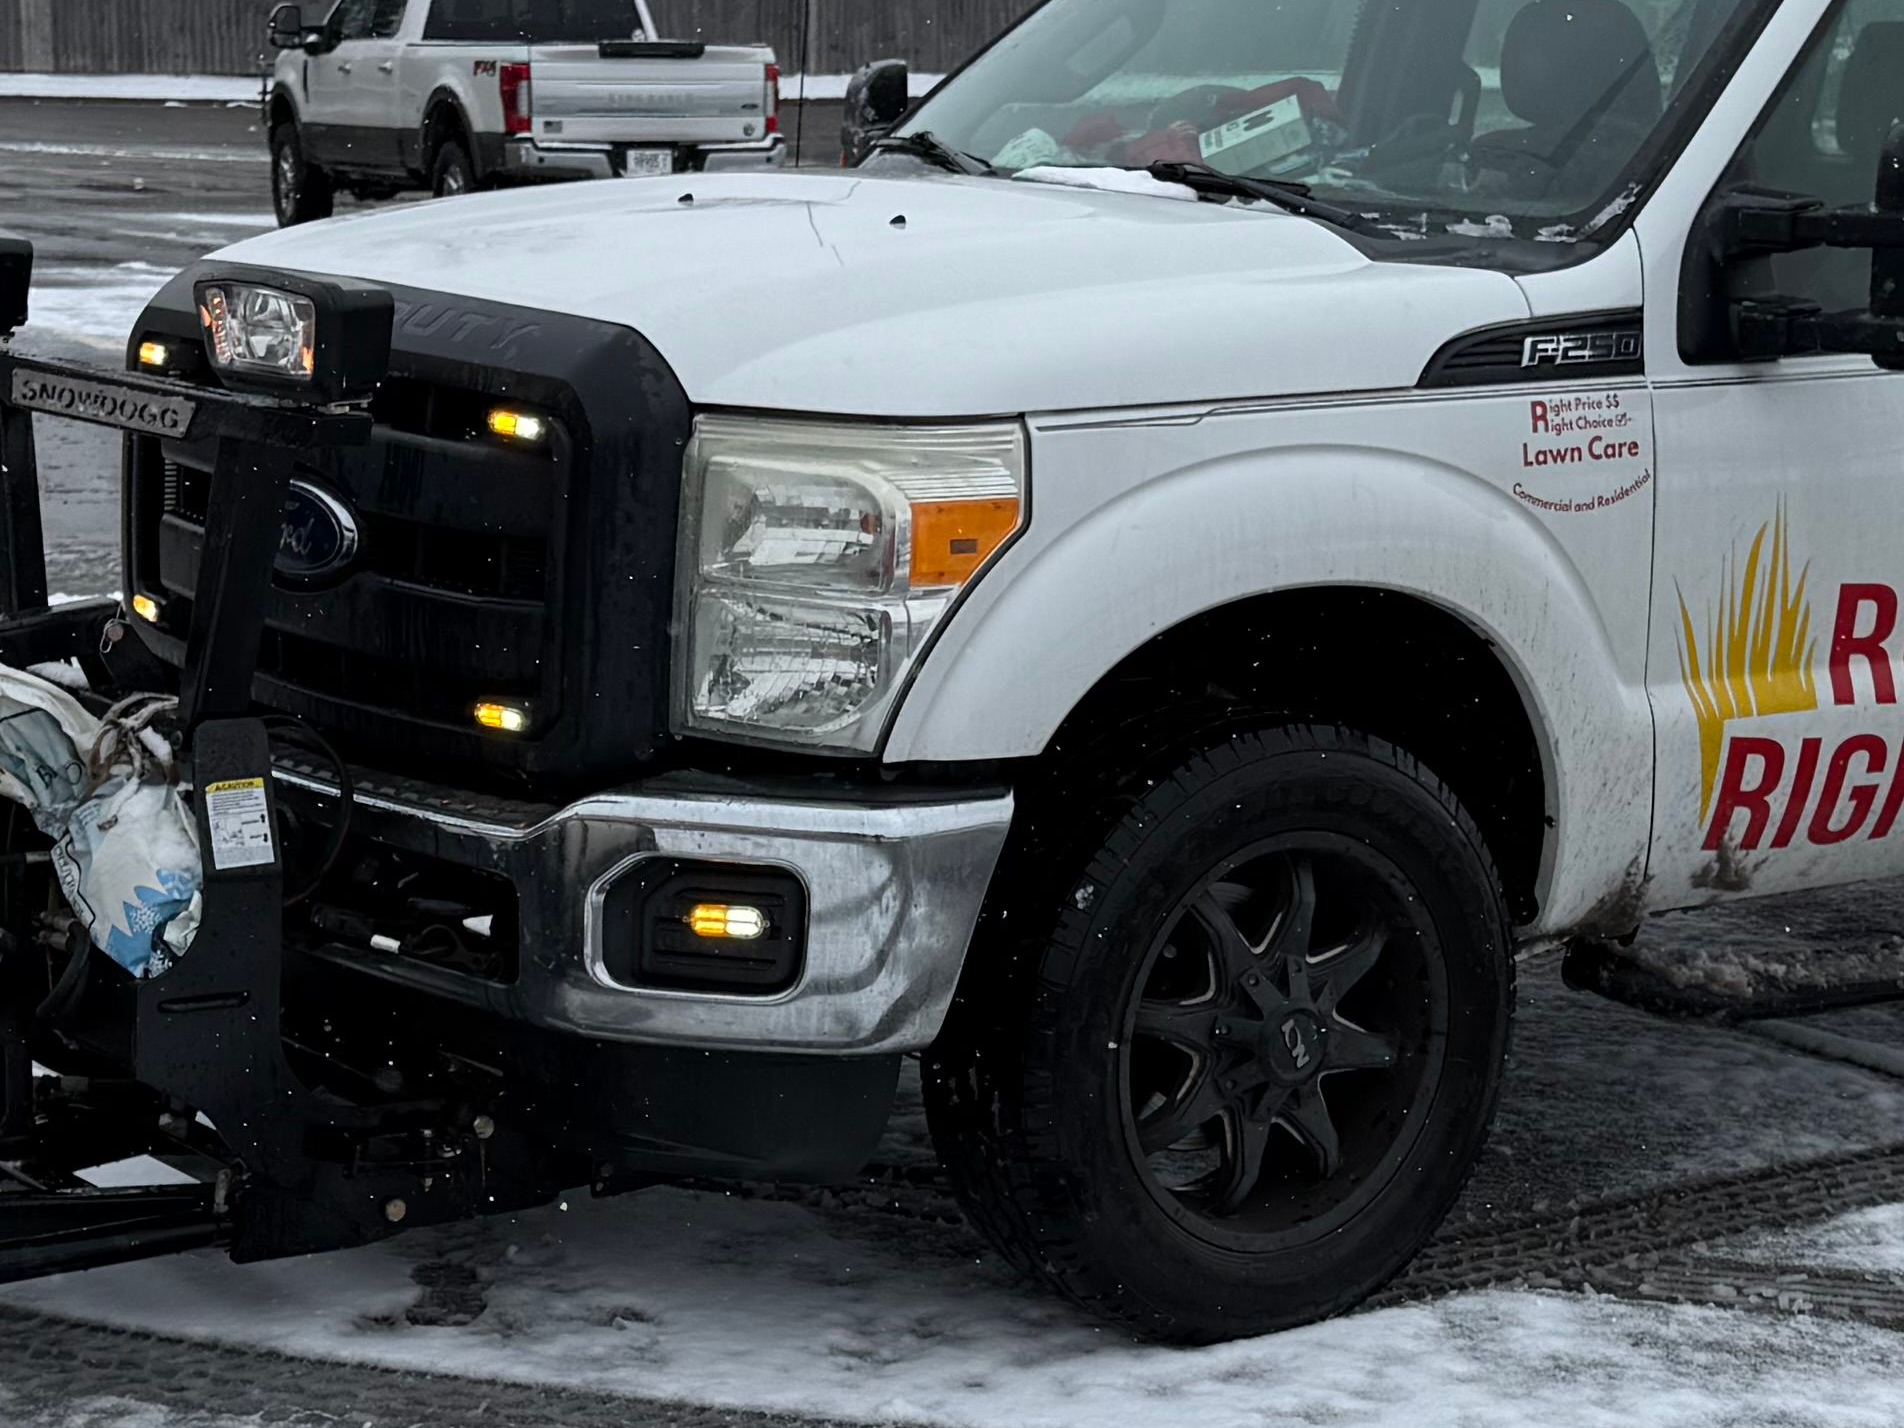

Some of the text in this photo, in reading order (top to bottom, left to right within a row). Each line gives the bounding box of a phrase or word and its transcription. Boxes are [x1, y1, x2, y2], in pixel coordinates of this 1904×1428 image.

[1521, 332, 1642, 367] F-250
[21, 379, 179, 429] SNOWDOGG
[1574, 396, 1603, 411] Price
[1576, 414, 1614, 430] Choice
[1523, 435, 1639, 467] Lawn Care
[1513, 468, 1651, 512] Commercial and Residential
